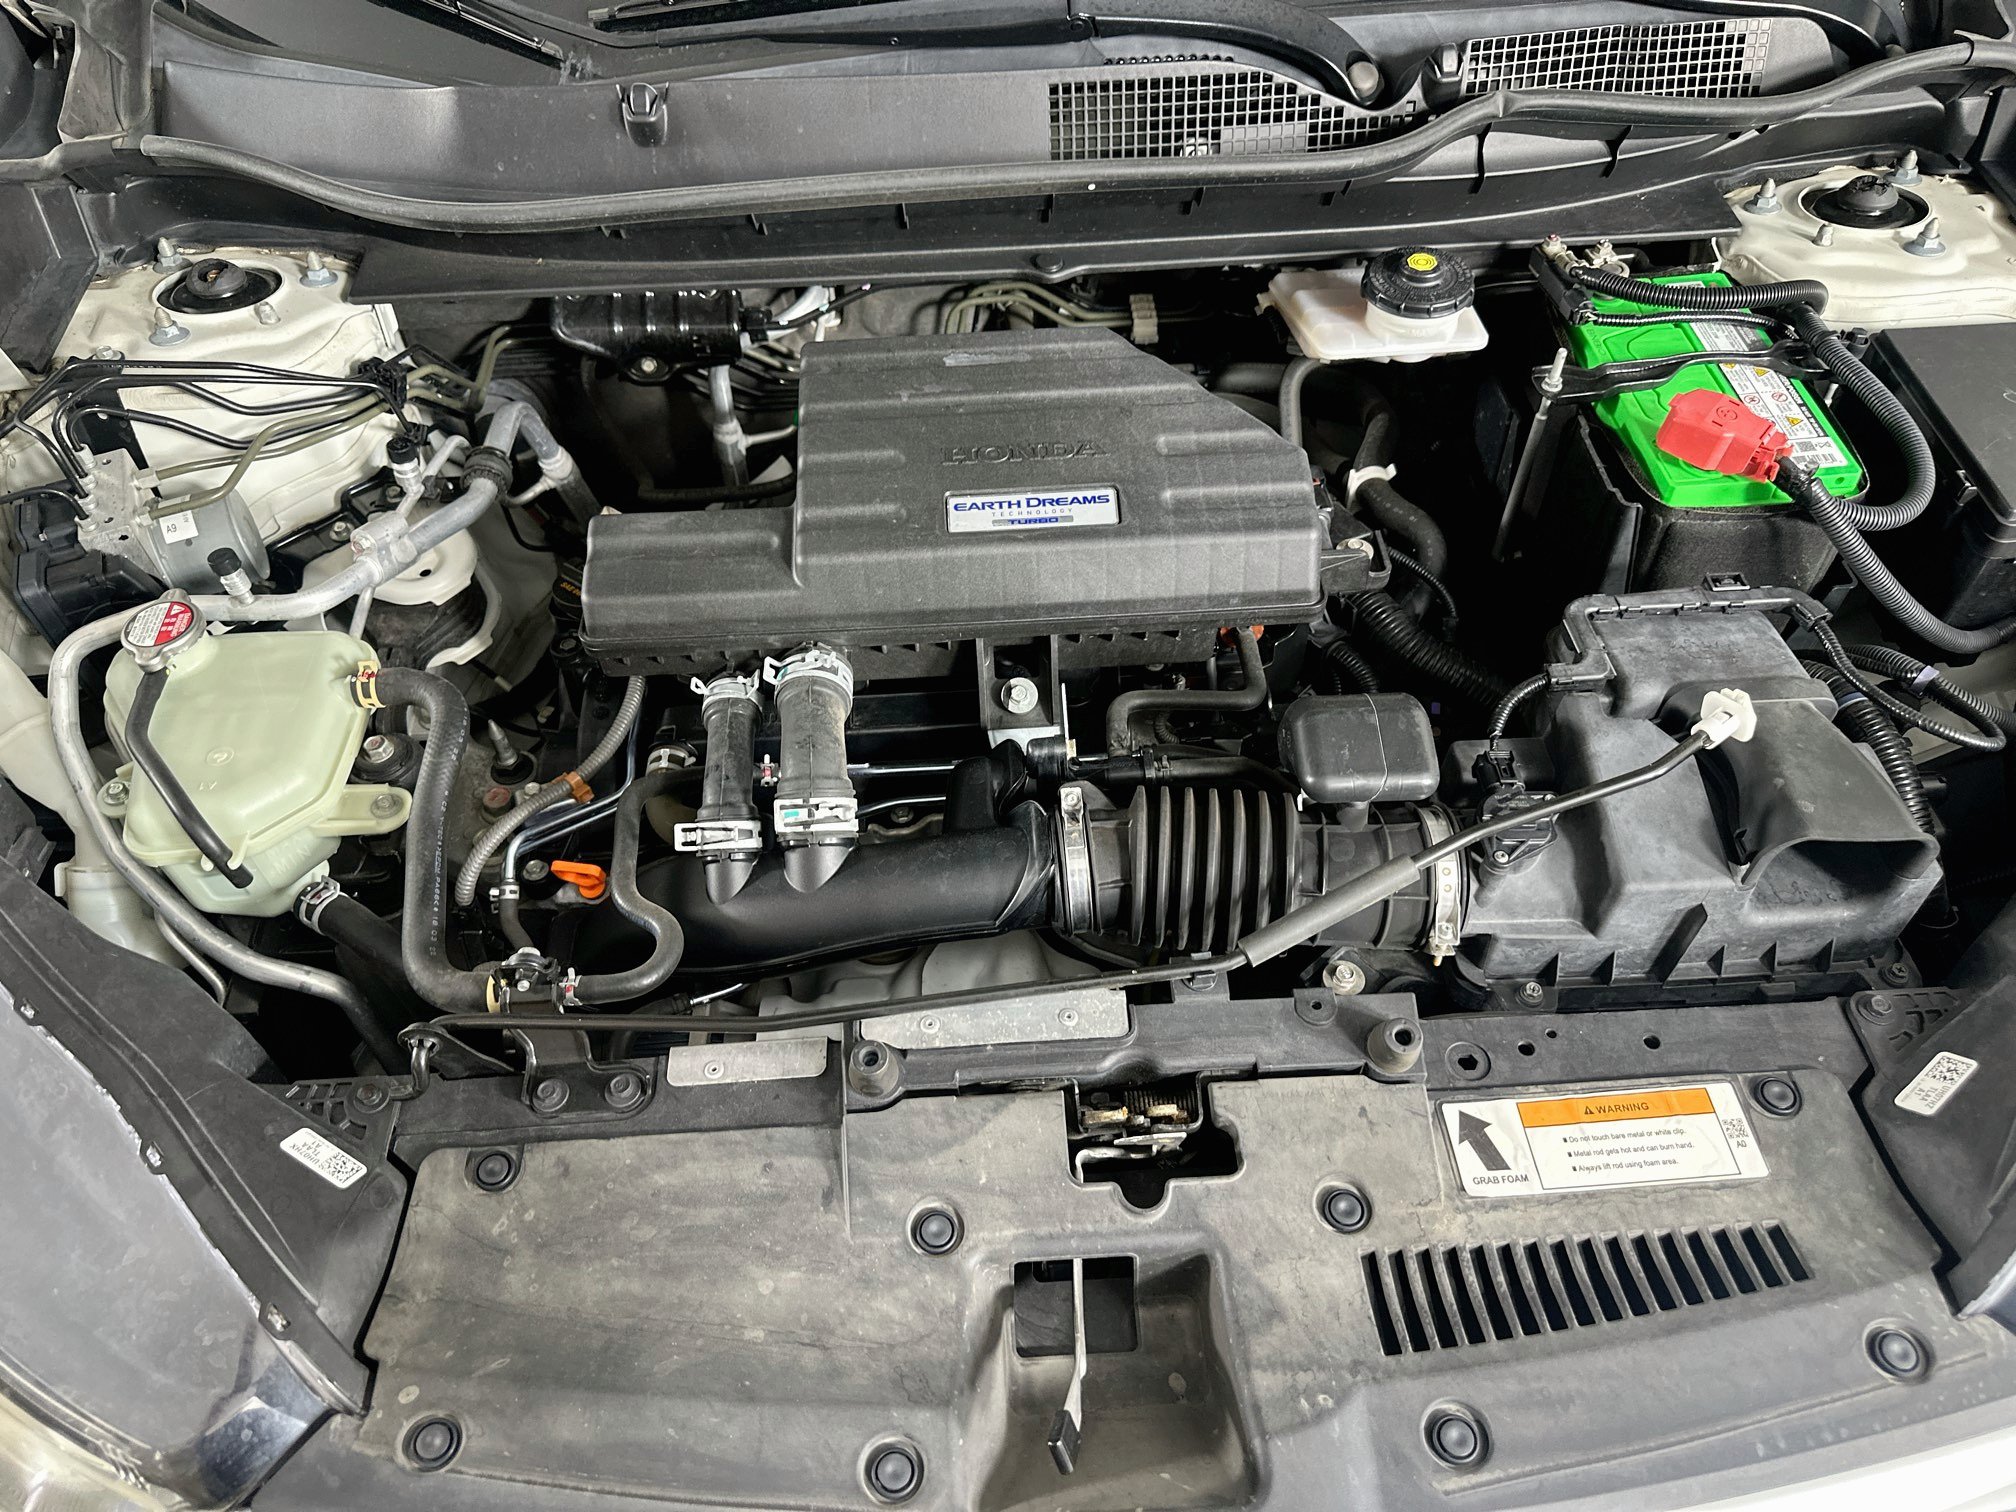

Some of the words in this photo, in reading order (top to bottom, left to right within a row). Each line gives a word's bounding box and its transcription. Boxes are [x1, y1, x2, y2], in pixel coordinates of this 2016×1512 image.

[942, 441, 1111, 465] HONDA
[953, 499, 1021, 512] EARTH
[1025, 494, 1110, 508] DREAMS
[992, 508, 1073, 517] TECHNOLOGY
[1007, 516, 1059, 526] TURBO
[166, 524, 177, 534] A9
[1595, 1102, 1650, 1114] WARNING
[1673, 1127, 1687, 1135] clip.
[1593, 1148, 1604, 1156] rod
[1605, 1147, 1619, 1156] gets
[1660, 1142, 1675, 1150] burn
[1578, 1164, 1602, 1174] Always
[1603, 1162, 1611, 1170] lift
[1624, 1160, 1643, 1169] using
[1643, 1159, 1661, 1167] foam
[1472, 1176, 1500, 1185] GRAB
[1502, 1174, 1529, 1183] FOAM
